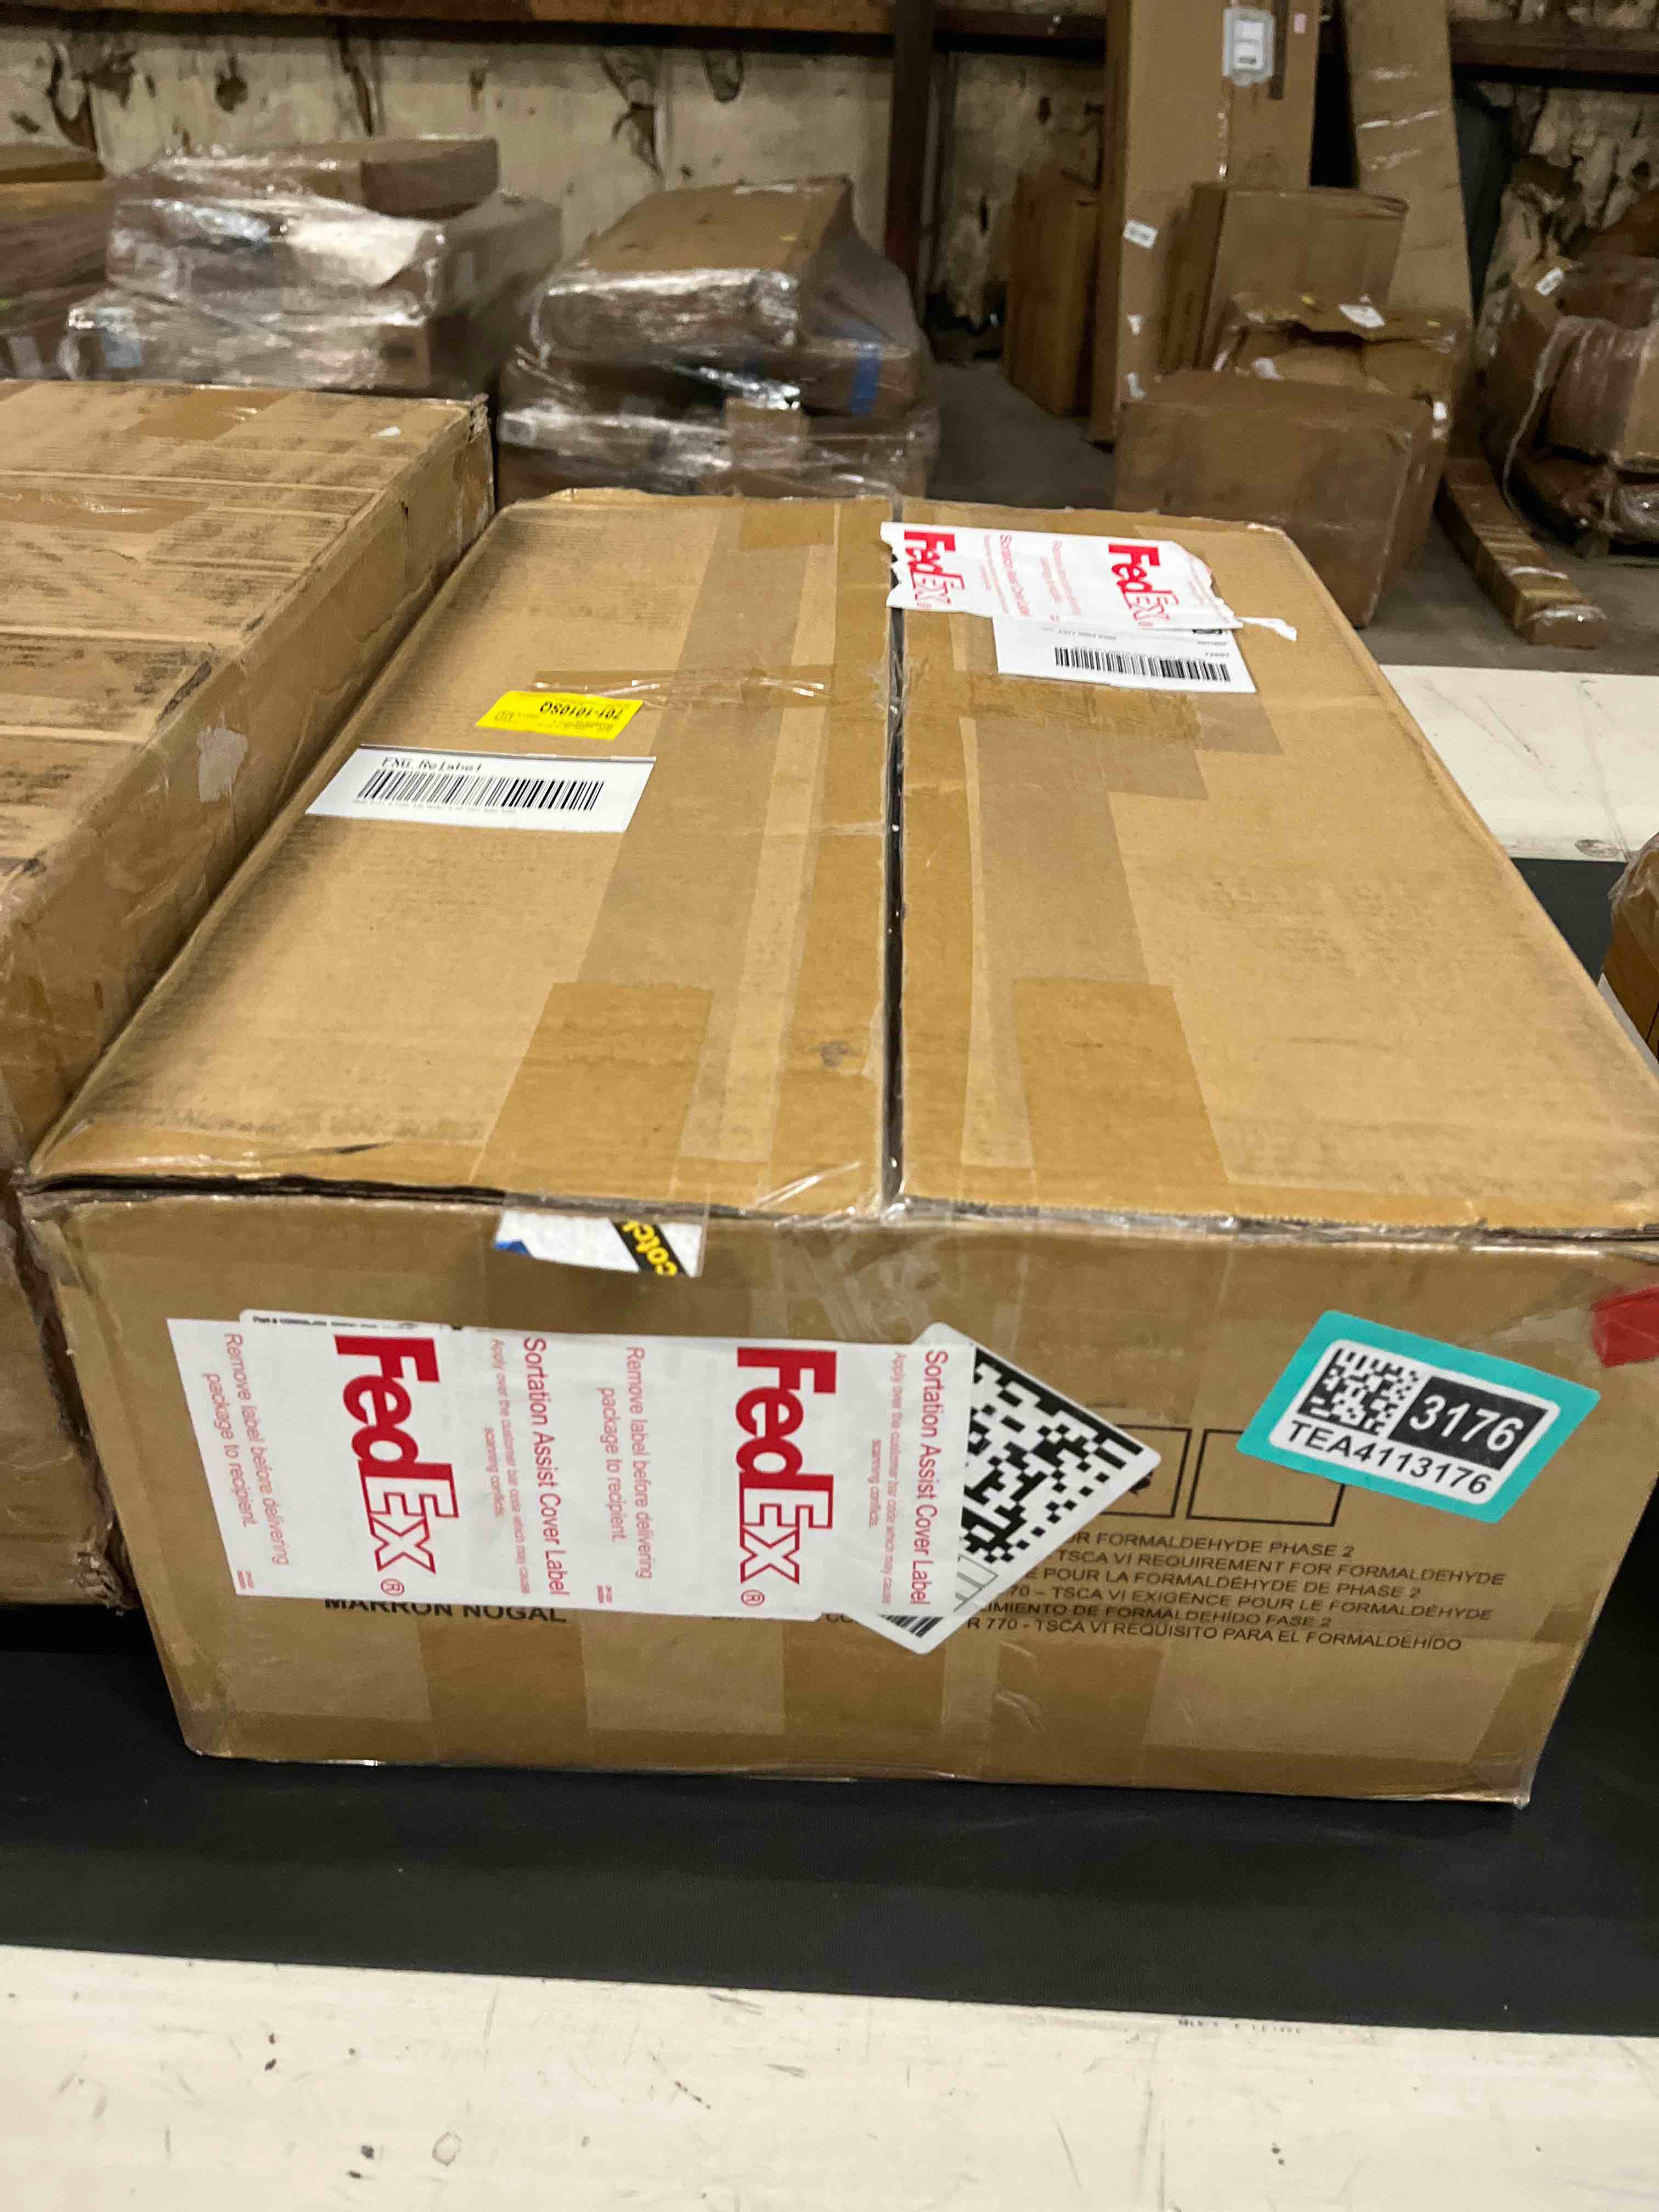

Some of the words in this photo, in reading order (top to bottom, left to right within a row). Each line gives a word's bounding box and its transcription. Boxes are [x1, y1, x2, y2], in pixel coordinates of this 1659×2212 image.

[904, 530, 964, 605] FedEx
[1108, 543, 1179, 620] FedEx
[224, 1333, 251, 1400] Remove
[523, 1336, 551, 1425] Sortation
[626, 1347, 646, 1414] Remove
[890, 1351, 907, 1383] Apply
[202, 1373, 234, 1440] package
[224, 1444, 240, 1459] to
[596, 1387, 621, 1453] package
[921, 1350, 949, 1438] Sortation
[241, 1404, 265, 1443] label
[631, 1419, 651, 1456] label
[1408, 1395, 1523, 1452] 3176
[251, 1447, 273, 1494] before
[334, 1335, 459, 1574] FedEx
[532, 1431, 558, 1487] Assist
[606, 1458, 623, 1473] to
[735, 1347, 837, 1585] FedEx
[917, 1442, 942, 1499] Assist
[1288, 1420, 1493, 1496] TEA4113176
[632, 1460, 652, 1508] before
[263, 1498, 290, 1564] delivering
[539, 1493, 562, 1545] Cover
[635, 1511, 656, 1580] delivering
[913, 1503, 938, 1556] Cover
[1097, 1531, 1263, 1553] FORMALDEHYDE
[1268, 1541, 1338, 1557] PHASE
[1342, 1545, 1355, 1558] 2
[545, 1550, 570, 1595] Label
[910, 1560, 934, 1605] Label
[1043, 1567, 1100, 1582] POUR
[1105, 1570, 1129, 1584] LA
[1303, 1581, 1331, 1595] DE
[1336, 1582, 1403, 1599] PHASE
[1408, 1587, 1421, 1599] 2
[1057, 1549, 1107, 1563] TSCA
[1113, 1553, 1131, 1565] VI
[1137, 1553, 1284, 1573] REQUIREMENT
[1289, 1562, 1332, 1576] FOR
[1336, 1564, 1506, 1586] FORMALDEHYDE
[1053, 1587, 1103, 1600] TSCA
[1109, 1589, 1125, 1601] VI
[1131, 1589, 1233, 1607] EXIGENCE
[1238, 1595, 1294, 1611] POUR
[1299, 1599, 1323, 1611] LE
[1073, 1604, 1098, 1617] DE
[1265, 1613, 1316, 1628] FASE
[1318, 1616, 1332, 1629] 2
[988, 1617, 1018, 1631] 770
[1035, 1618, 1086, 1634] TSCA
[1091, 1621, 1107, 1634] VI
[1113, 1622, 1218, 1640] REQUISITO
[1222, 1627, 1274, 1643] PARA
[1277, 1629, 1300, 1644] EL
